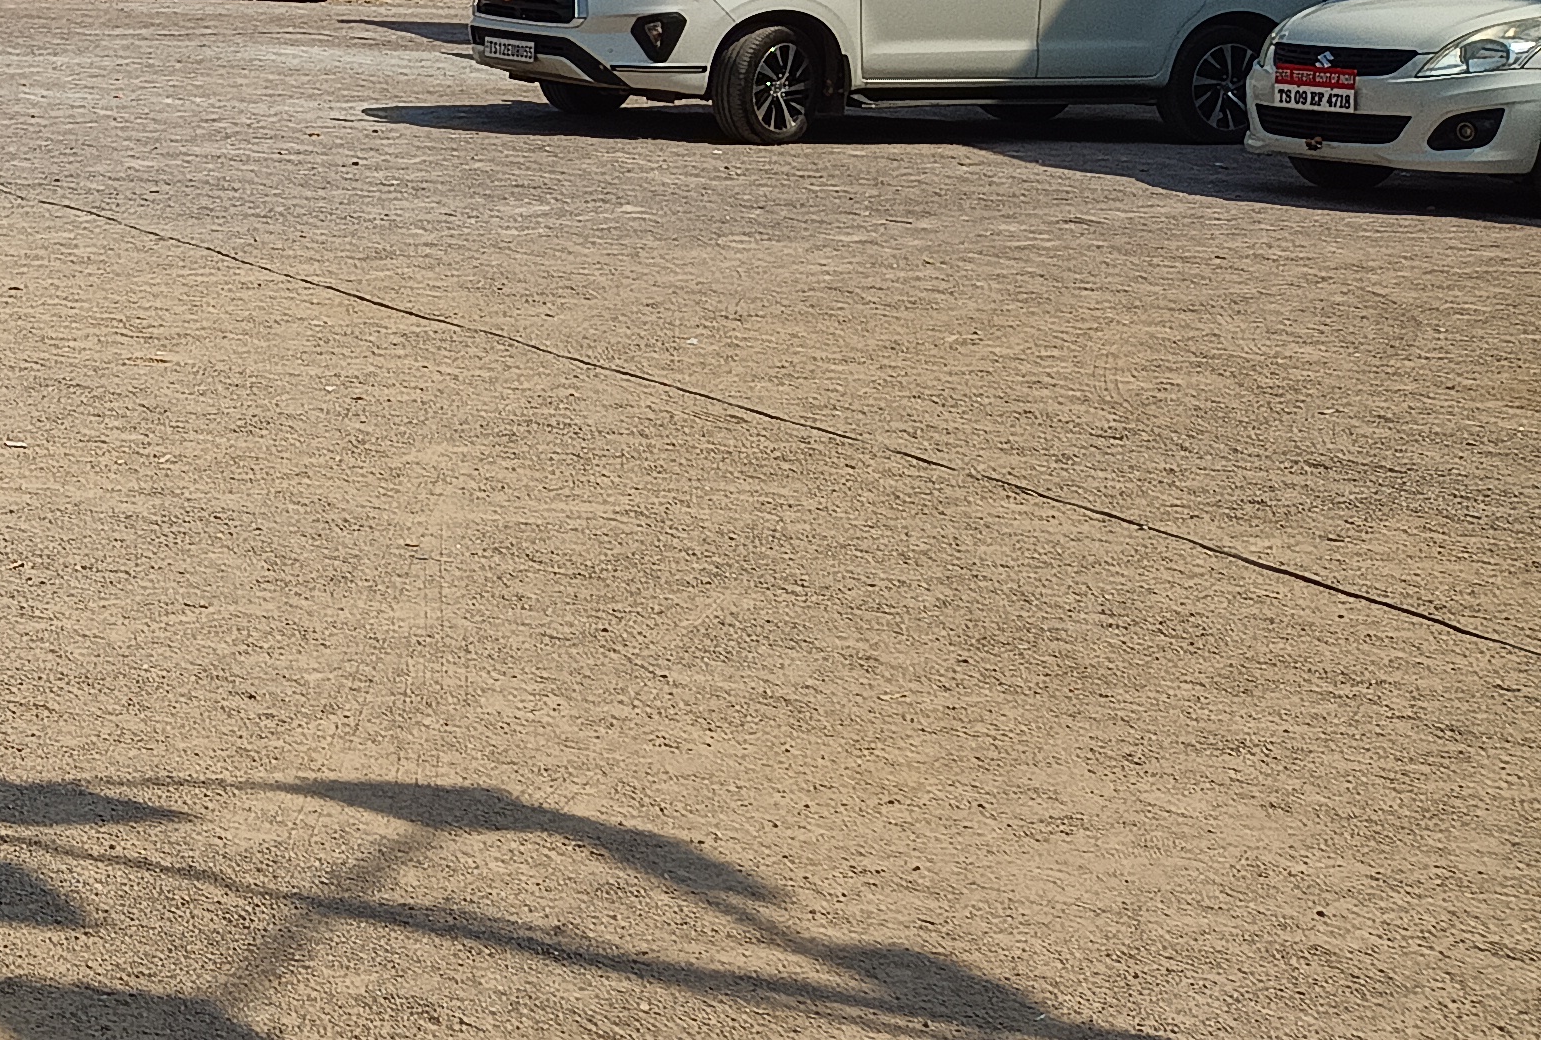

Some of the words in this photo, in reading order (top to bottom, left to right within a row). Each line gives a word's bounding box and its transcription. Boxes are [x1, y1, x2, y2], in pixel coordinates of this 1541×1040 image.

[1278, 89, 1292, 103] TS
[1294, 90, 1307, 105] 09
[1326, 93, 1351, 109] 4718
